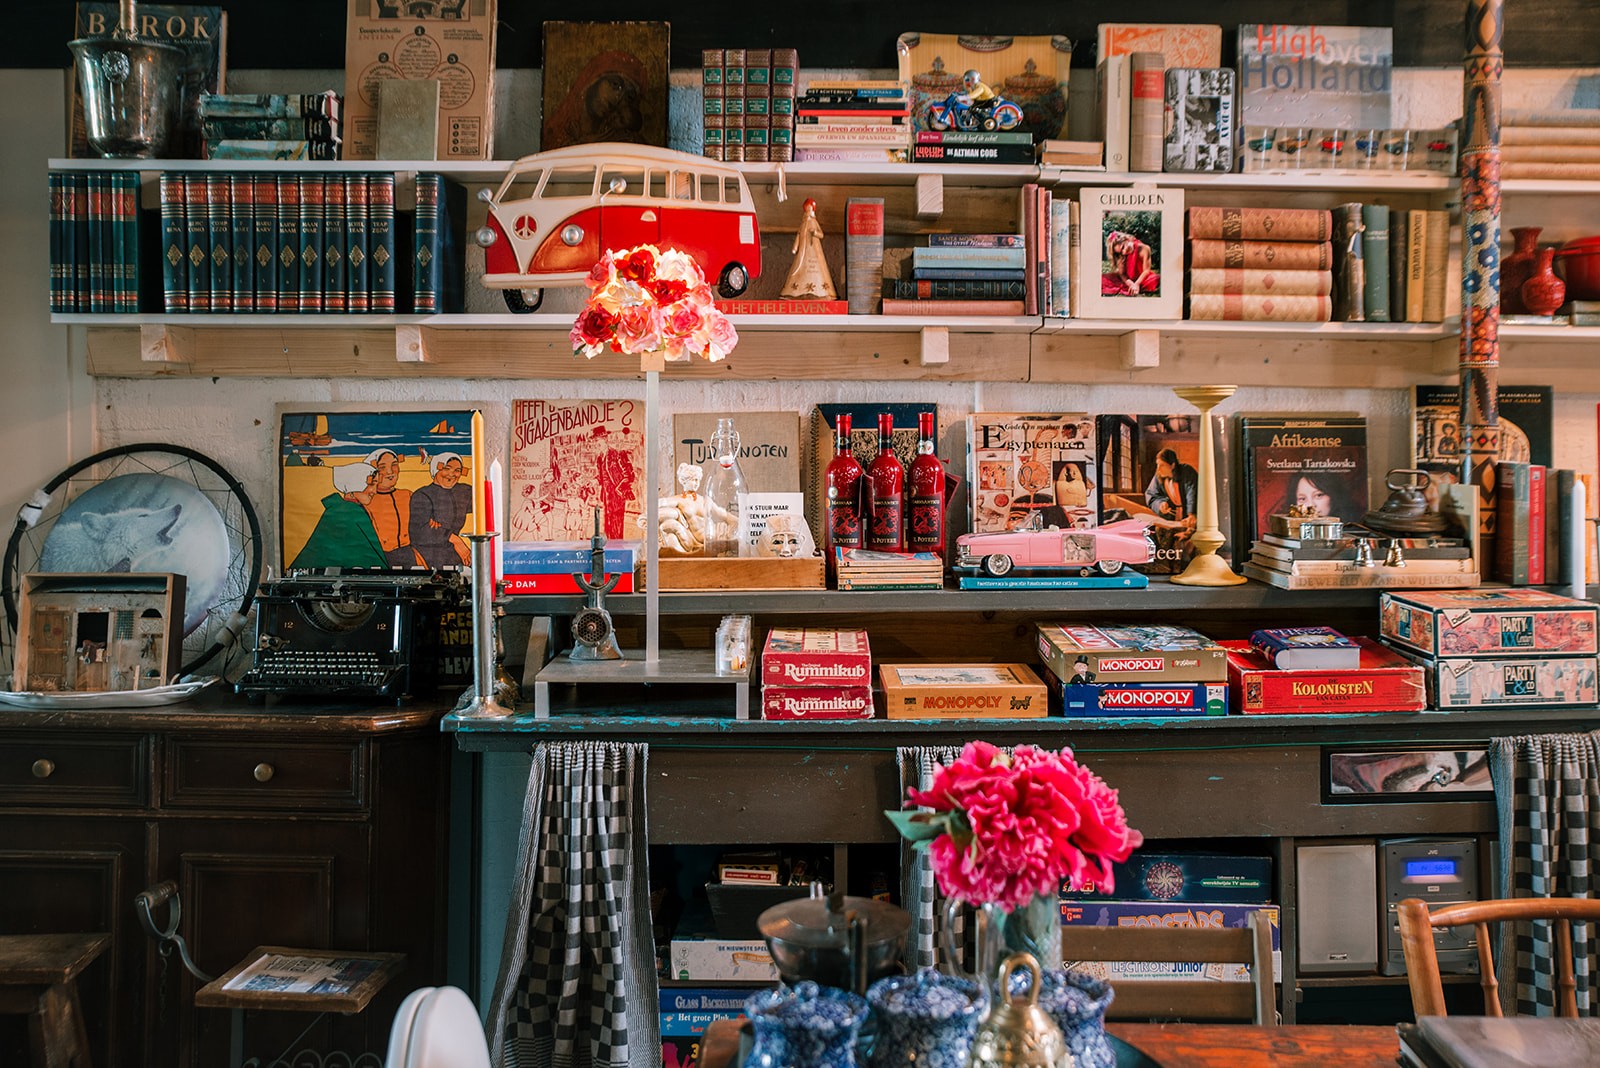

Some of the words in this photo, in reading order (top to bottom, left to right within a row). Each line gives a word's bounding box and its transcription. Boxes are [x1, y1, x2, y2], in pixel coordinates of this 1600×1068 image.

[88, 12, 209, 39] BROK
[1257, 24, 1326, 62] High
[1317, 43, 1382, 65] over
[1243, 53, 1389, 91] Holland
[827, 125, 848, 133] Leven
[849, 125, 875, 133] zonder
[875, 125, 897, 133] stress
[819, 153, 841, 161] ROSA
[915, 146, 944, 155] LUDLUM
[953, 148, 980, 158] ALTMAN
[980, 148, 999, 158] CODE
[1099, 194, 1165, 206] CHILDREN
[732, 302, 754, 314] HET
[758, 302, 787, 314] HELE
[788, 302, 828, 314] LEVEN
[514, 400, 546, 427] HEEFT
[514, 402, 615, 454] SIGARENBANDJE
[981, 424, 1086, 452] Egyptenaren
[1269, 433, 1343, 448] Afrikaanse
[1266, 458, 1303, 469] Svetlana
[1303, 458, 1357, 469] Tartakovska
[516, 580, 537, 589] DAM
[1428, 575, 1463, 585] LEVEN
[284, 621, 294, 629] 12
[376, 622, 387, 631] 12
[1501, 617, 1529, 633] PARTY
[1502, 632, 1518, 648] XX
[1100, 659, 1162, 671] MONOPOLY
[784, 663, 866, 682] Rummikub
[1505, 666, 1536, 681] PARTY
[1292, 680, 1375, 696] KOLONISTEN
[1513, 680, 1526, 695] &
[923, 696, 1003, 709] MONOPOLY
[1107, 691, 1191, 705] MONOPOLY
[784, 697, 866, 716] Rummikub
[1171, 961, 1205, 973] Junior
[678, 1013, 691, 1021] Het
[692, 1014, 711, 1023] grote
